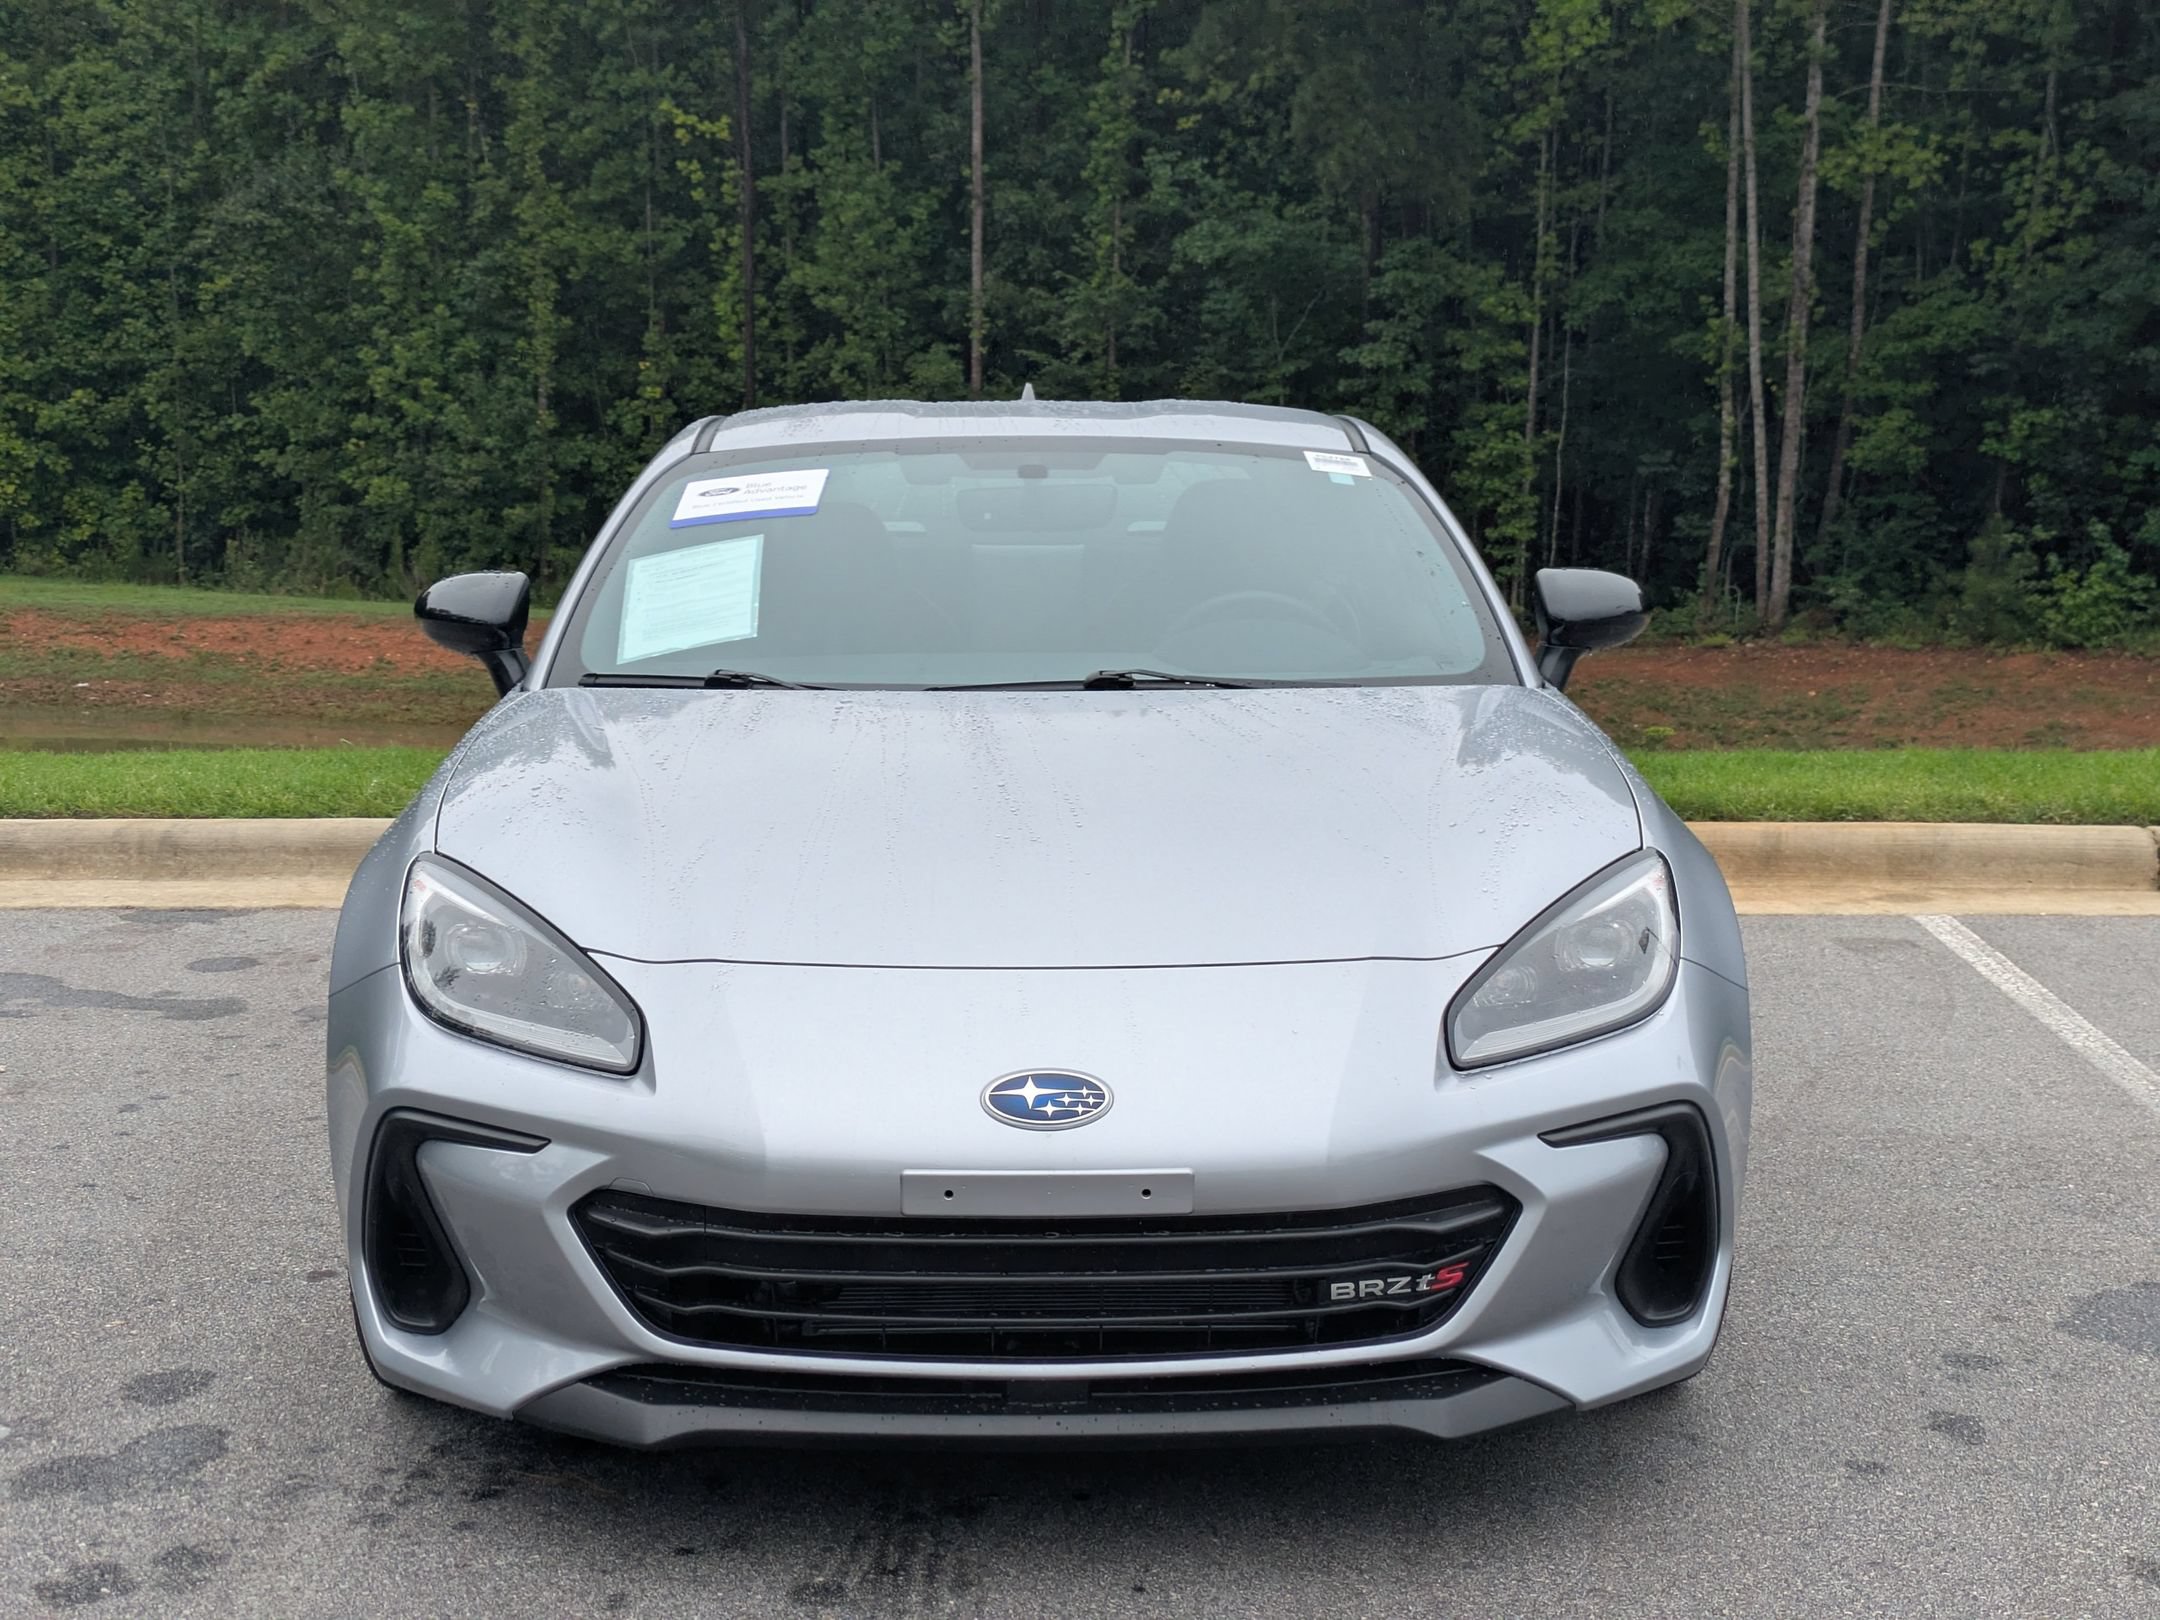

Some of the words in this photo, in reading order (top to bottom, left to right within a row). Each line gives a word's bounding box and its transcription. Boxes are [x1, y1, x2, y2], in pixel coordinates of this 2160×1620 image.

[743, 484, 808, 495] Advantage
[1330, 1276, 1412, 1301] BRZ
[1415, 1262, 1471, 1292] tS
